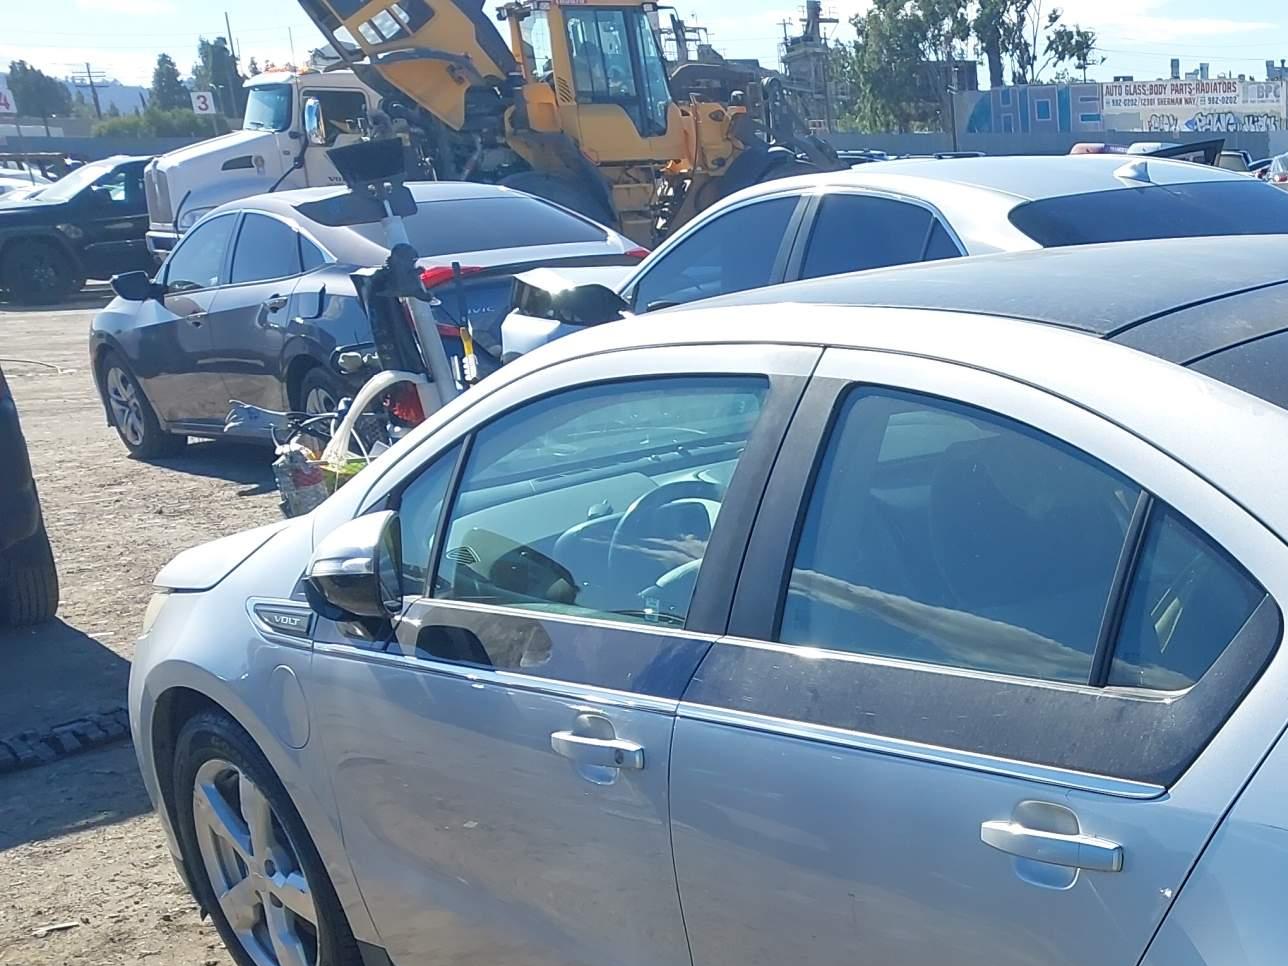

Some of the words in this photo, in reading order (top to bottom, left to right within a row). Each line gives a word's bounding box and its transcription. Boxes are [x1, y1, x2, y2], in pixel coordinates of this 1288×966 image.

[1105, 84, 1122, 97] AUTO
[197, 94, 209, 111] 3
[274, 615, 300, 626] VOLT
